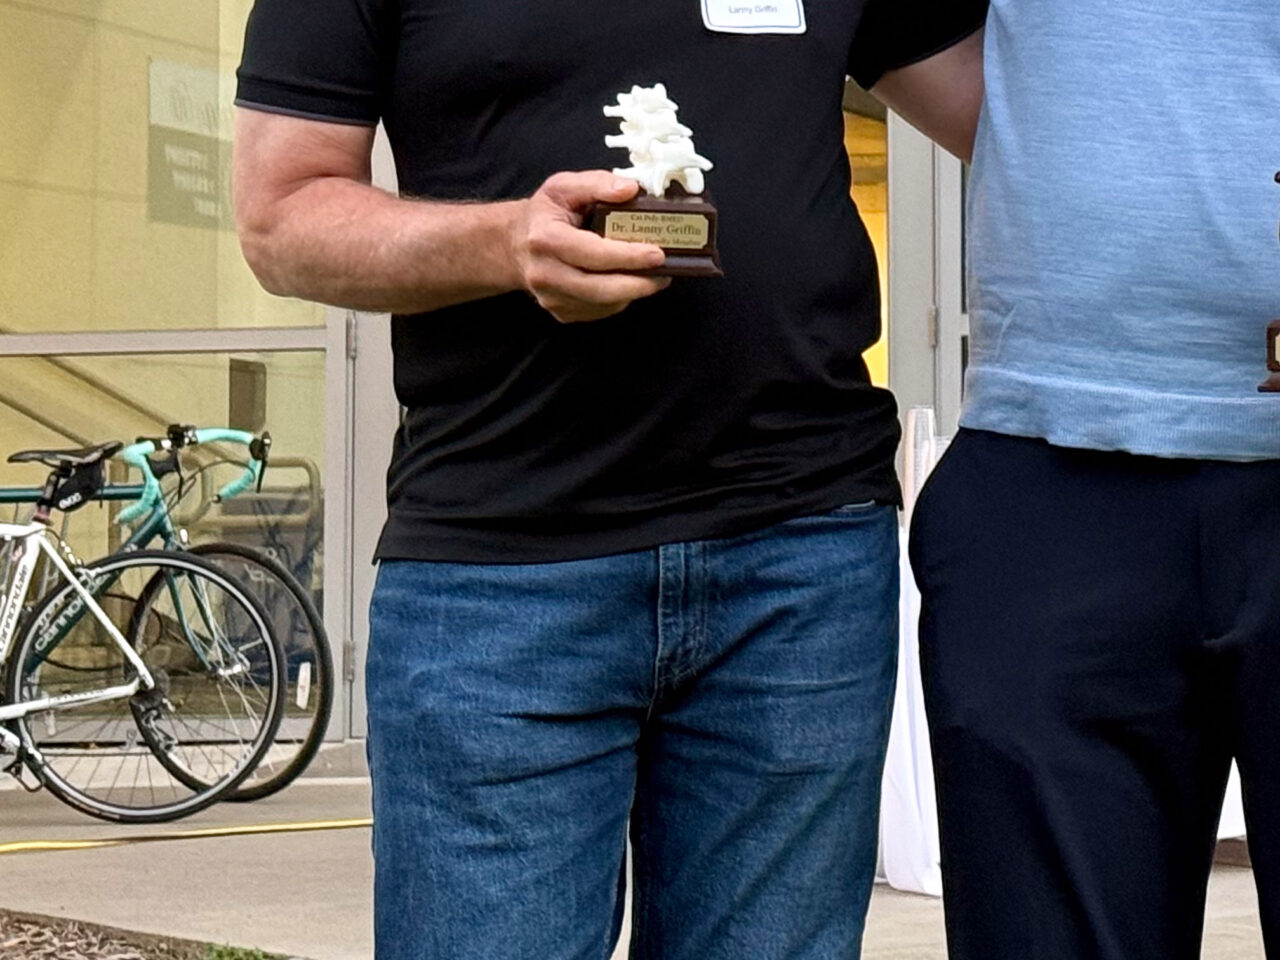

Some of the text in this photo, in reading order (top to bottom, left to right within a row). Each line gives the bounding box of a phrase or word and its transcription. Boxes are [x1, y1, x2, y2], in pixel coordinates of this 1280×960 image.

[612, 222, 702, 236] Dr. Lanny Griffin
